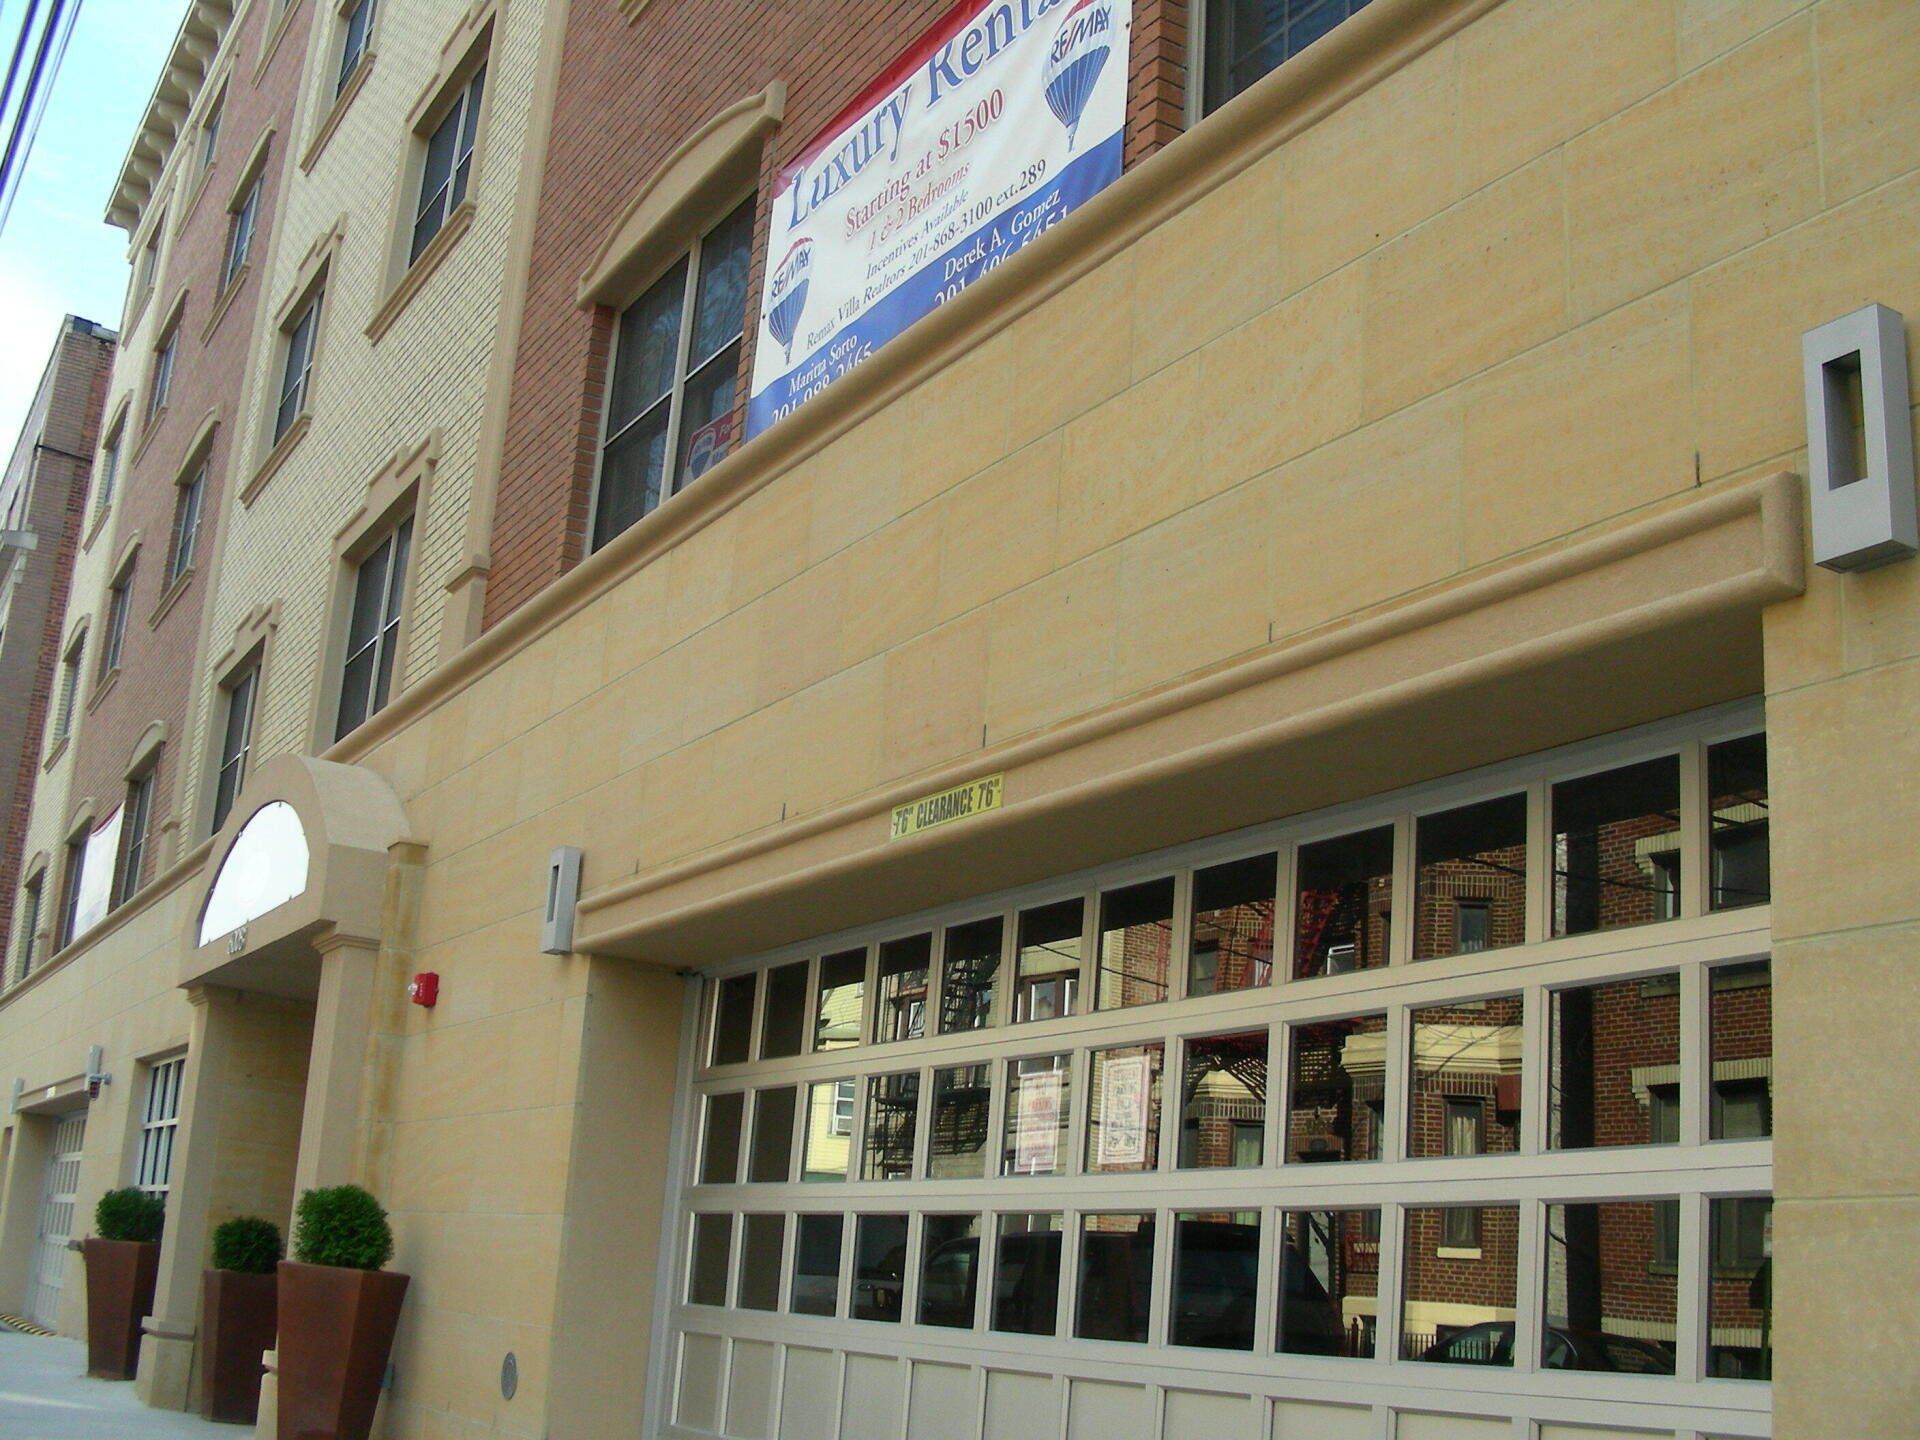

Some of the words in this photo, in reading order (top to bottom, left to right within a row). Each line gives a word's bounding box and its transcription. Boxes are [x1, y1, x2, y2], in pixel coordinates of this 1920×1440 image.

[1051, 5, 1112, 67] RE/MAX
[788, 84, 912, 231] Luxury
[846, 171, 911, 238] Starting
[915, 150, 932, 179] at
[938, 88, 1003, 161] $1500
[895, 207, 905, 230] 2
[907, 162, 970, 221] Bedrooms
[771, 247, 812, 298] RE/MAX
[806, 318, 835, 350] Remax
[838, 296, 861, 321] Villa
[863, 264, 906, 304] Realtors
[908, 197, 993, 271] 201-868-3100
[865, 232, 919, 280] Incentives
[922, 189, 969, 236] Available
[943, 237, 987, 282] Derek
[990, 227, 1006, 253] A.
[1011, 188, 1061, 236] Gomez
[788, 358, 827, 397] Maritza
[828, 334, 858, 366] Sorto
[916, 786, 974, 829] CLEARANCE
